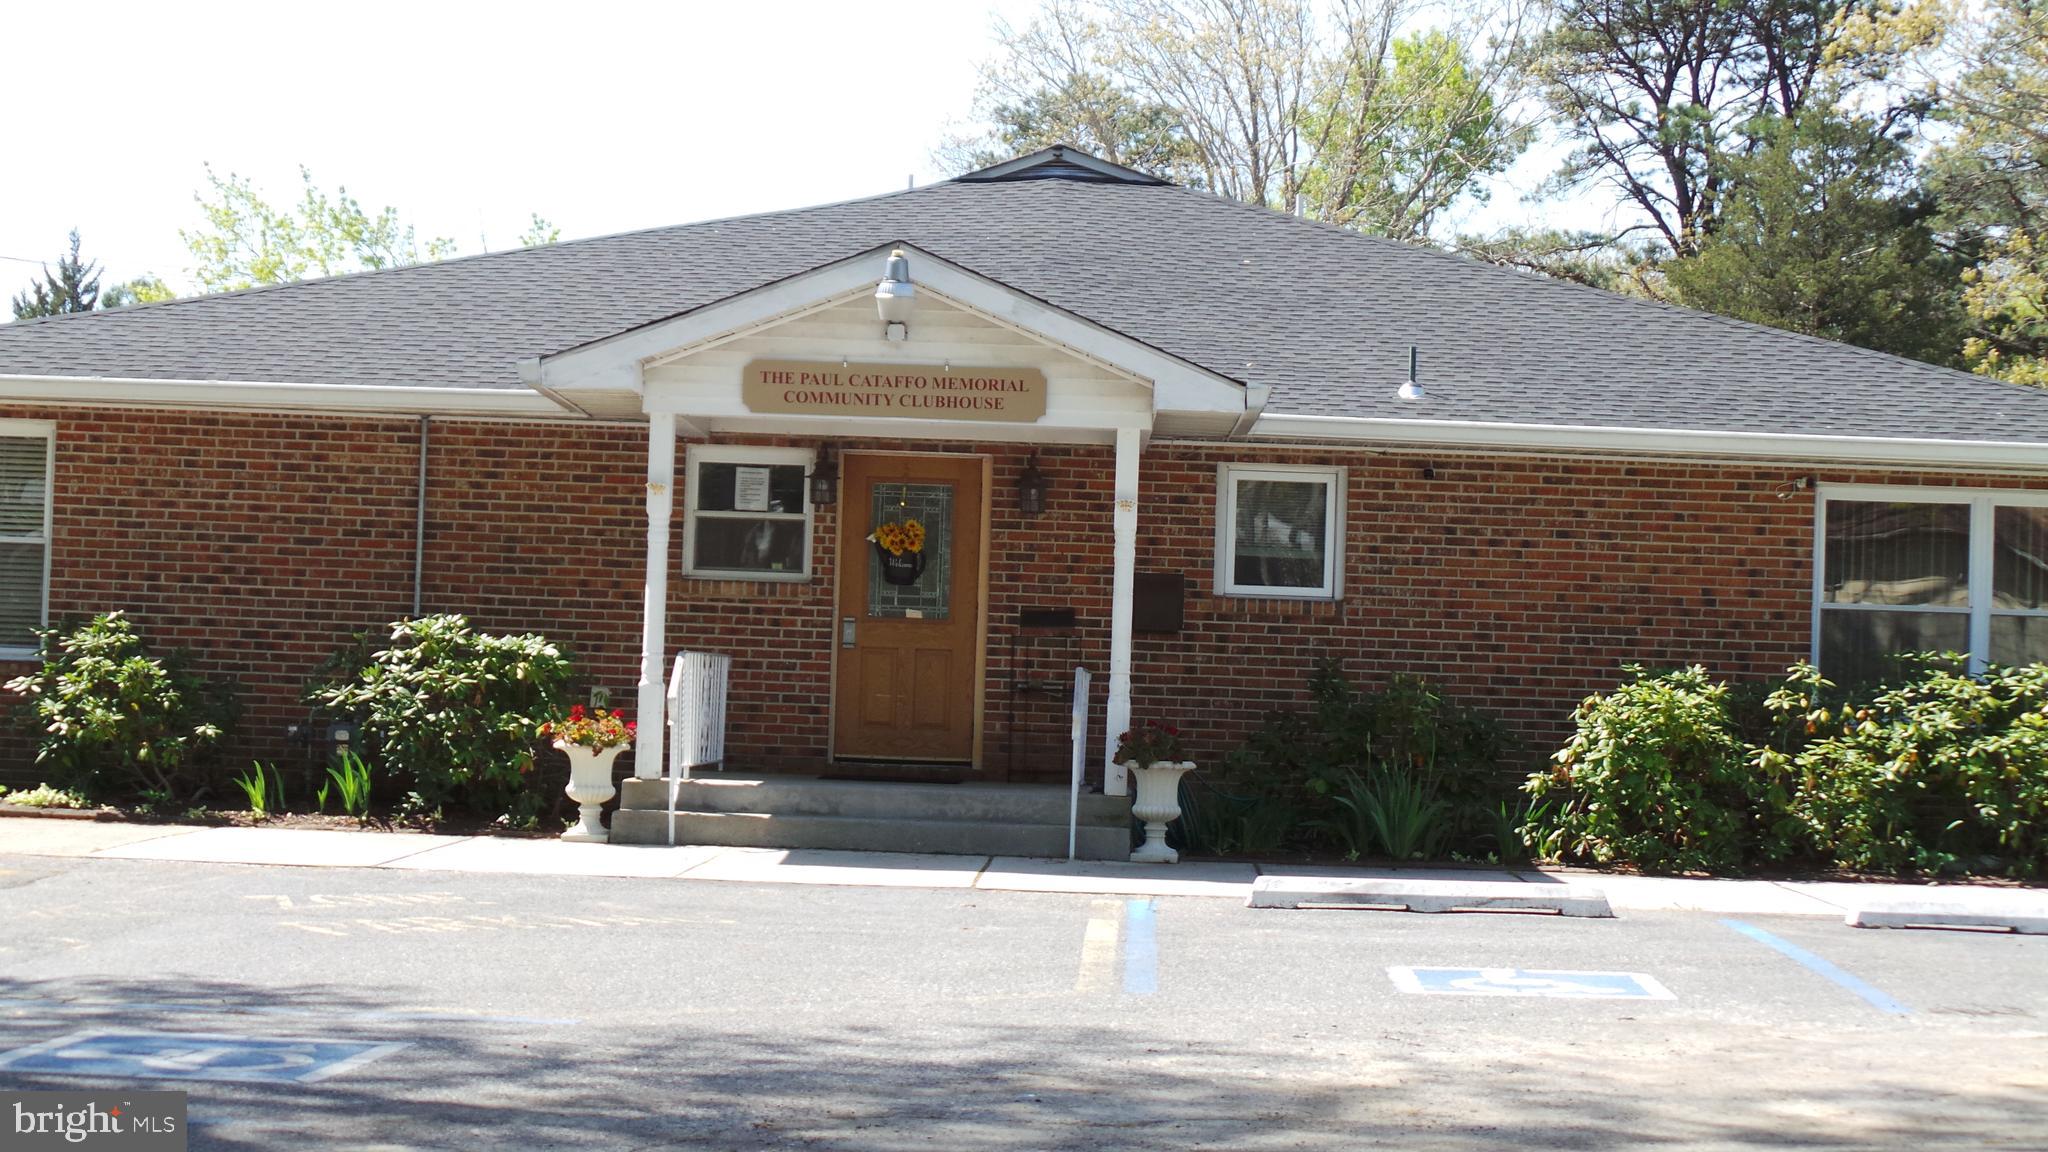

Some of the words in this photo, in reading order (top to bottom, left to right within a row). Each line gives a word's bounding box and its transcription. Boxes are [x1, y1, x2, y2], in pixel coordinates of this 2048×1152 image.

[759, 370, 795, 385] THE
[799, 372, 844, 387] PAUL
[848, 374, 927, 389] CATAFFO
[932, 376, 1030, 392] MEMORIAL
[783, 390, 897, 407] COMMUNITY
[899, 394, 1005, 410] CLUBHOUSE
